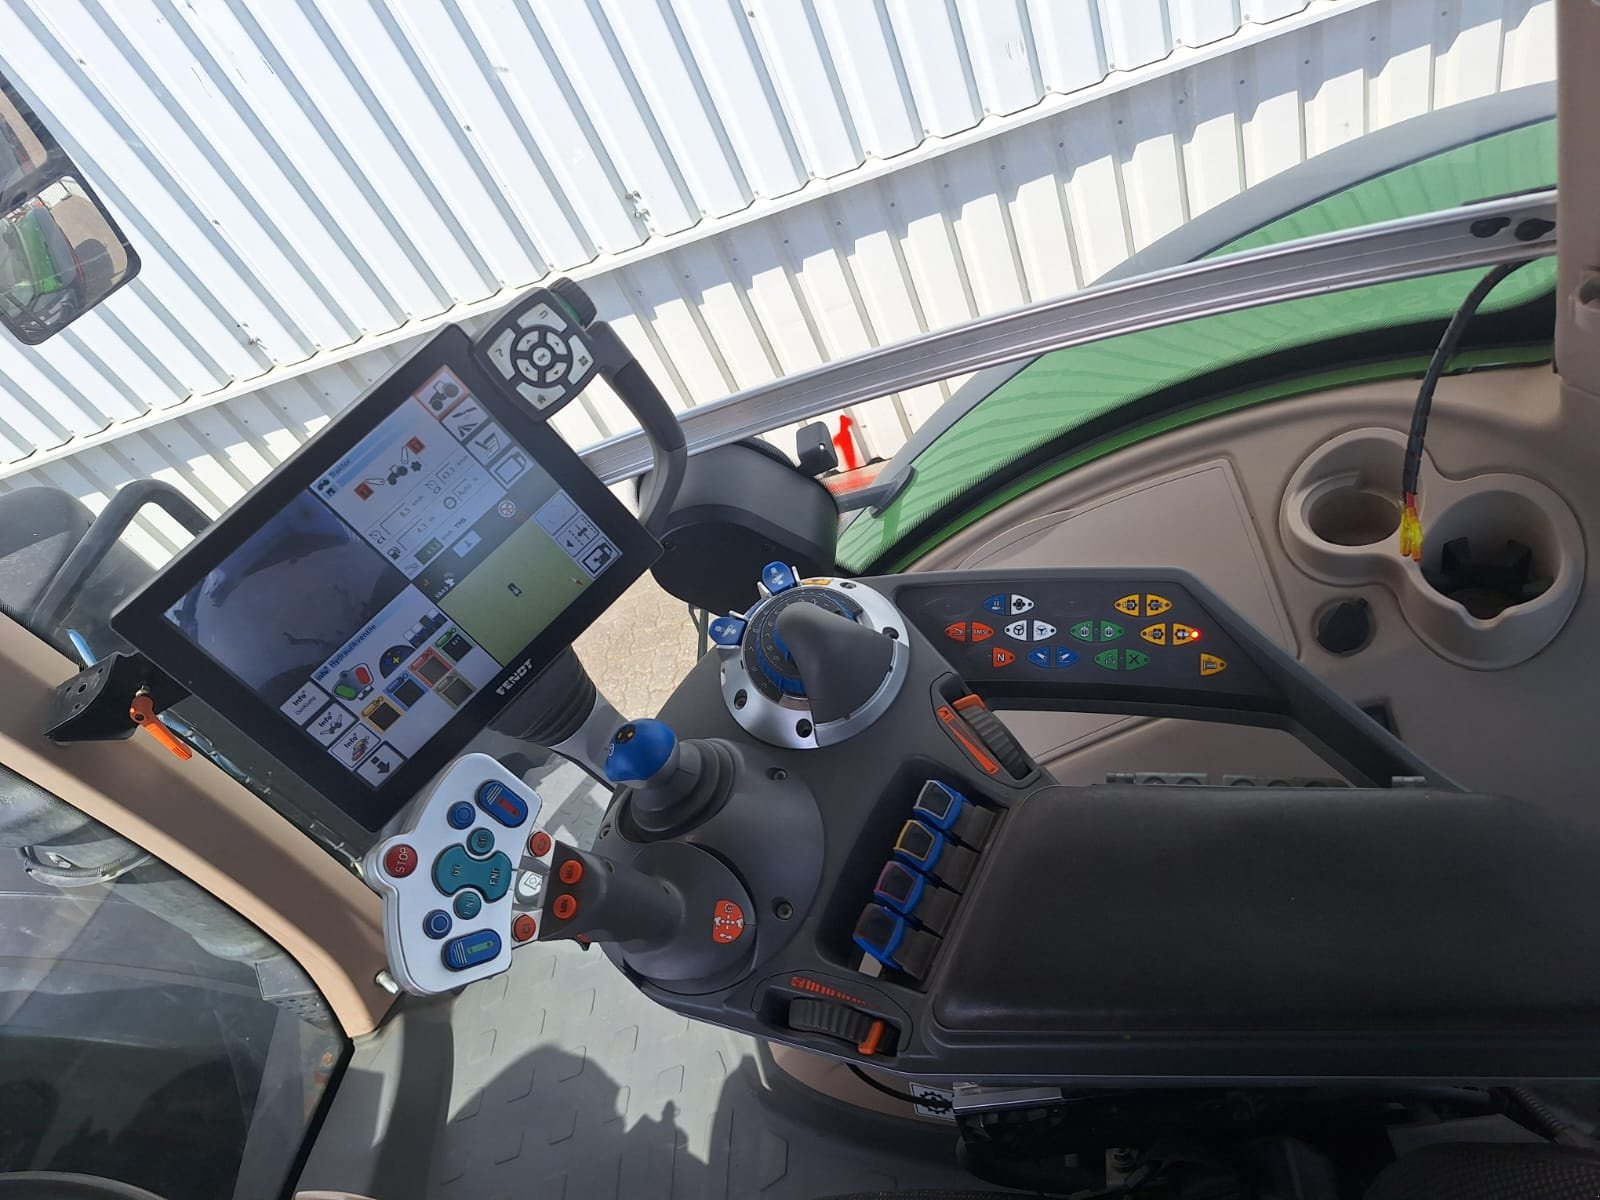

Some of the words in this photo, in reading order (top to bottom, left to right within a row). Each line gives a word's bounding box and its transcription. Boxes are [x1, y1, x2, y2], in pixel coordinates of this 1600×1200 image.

[329, 622, 377, 668] Hydraulikventile
[996, 653, 1005, 662] N
[496, 658, 534, 696] FENDT
[395, 847, 409, 873] STOP
